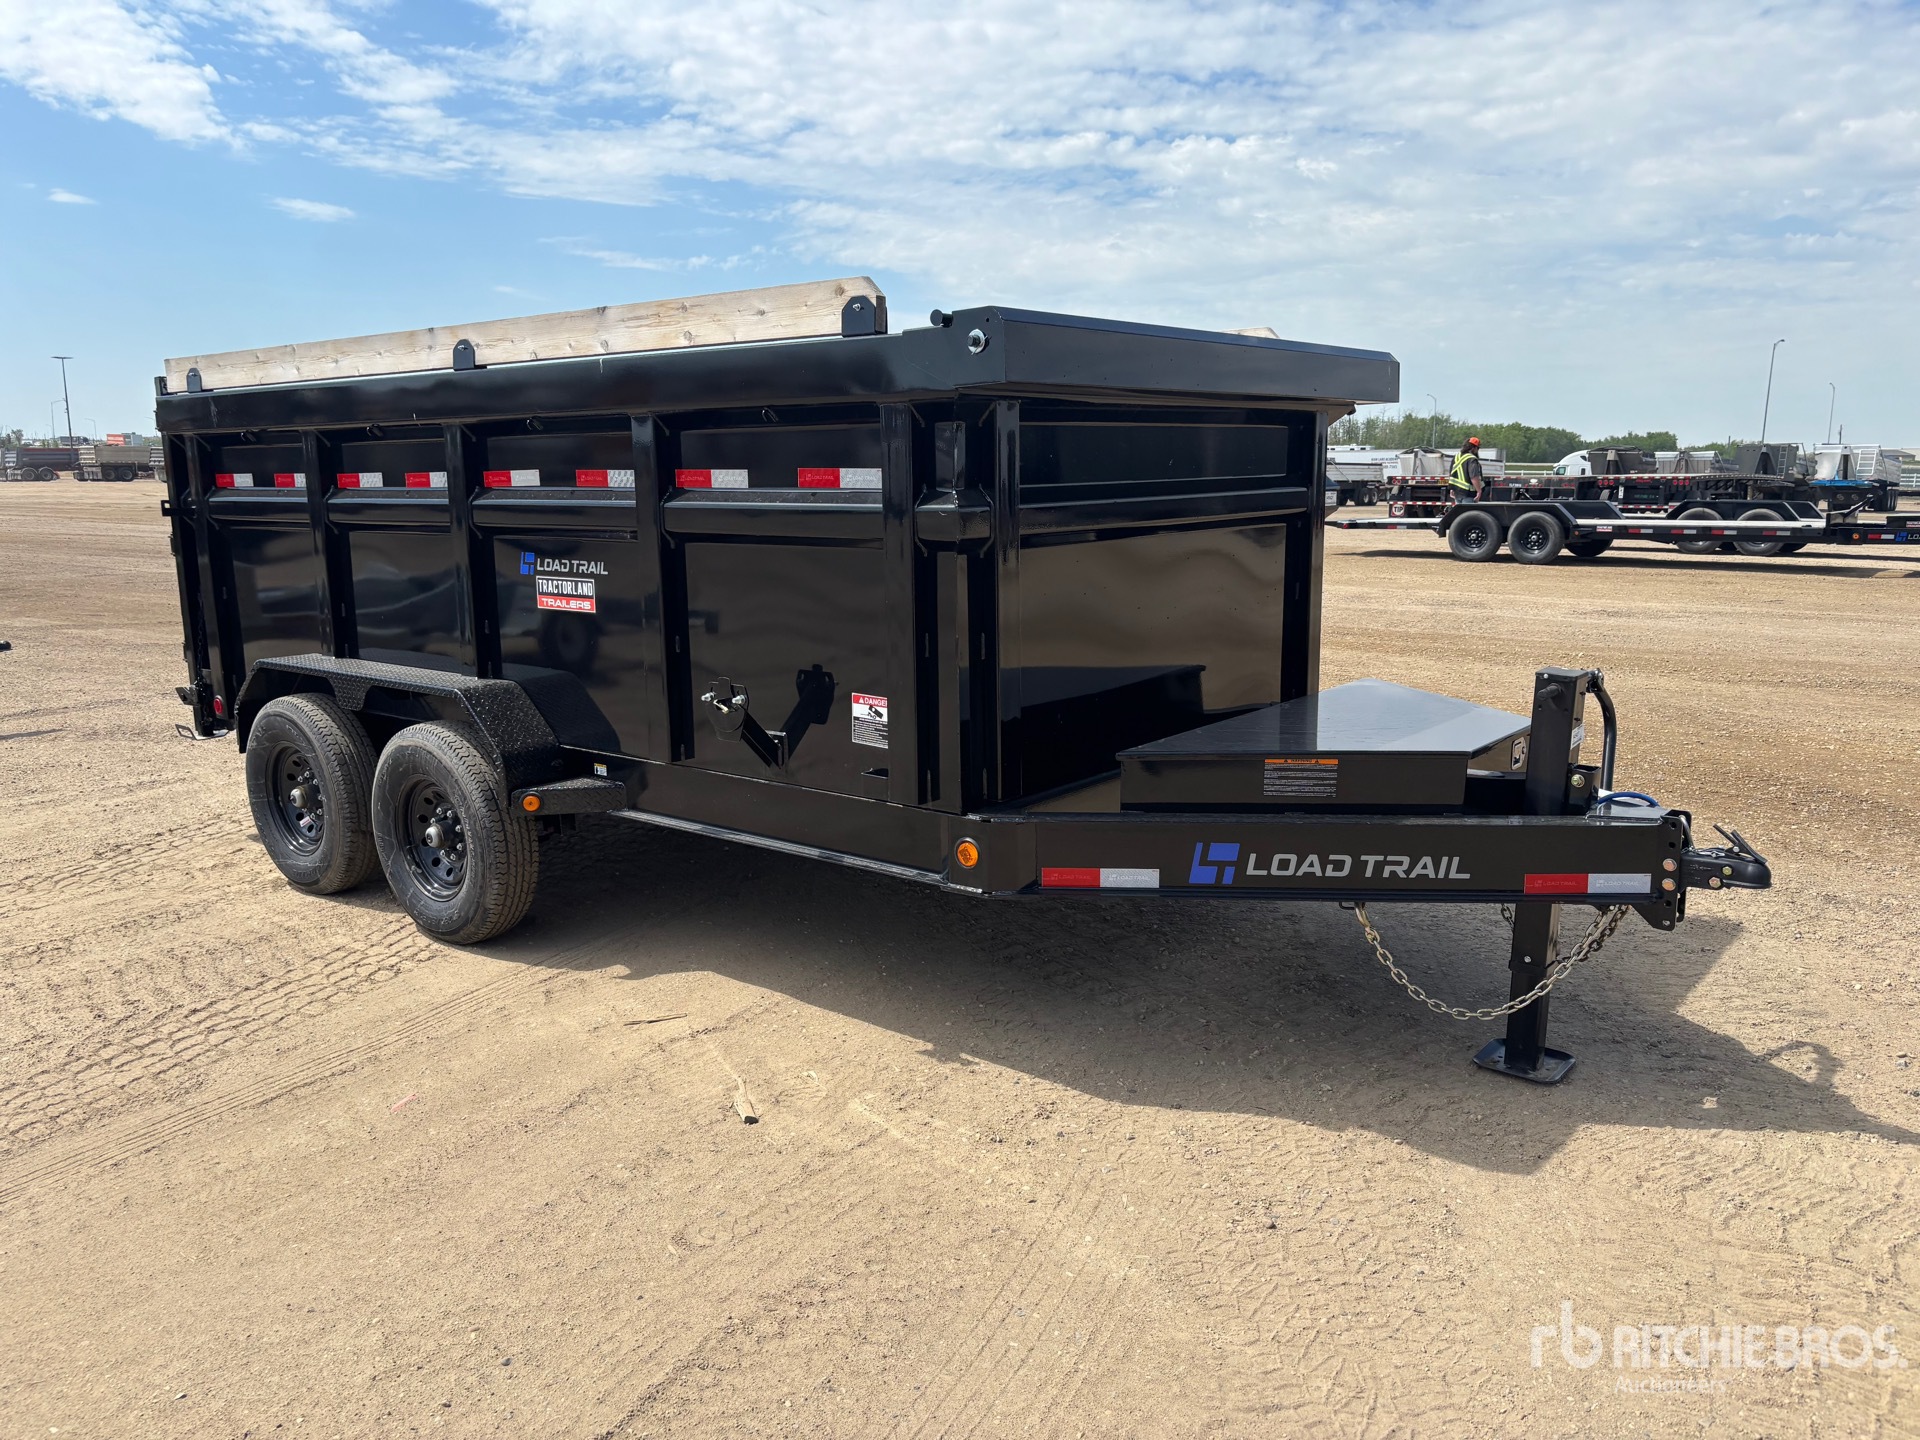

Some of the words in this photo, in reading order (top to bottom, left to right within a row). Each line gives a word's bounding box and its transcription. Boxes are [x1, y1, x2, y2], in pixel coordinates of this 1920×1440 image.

[537, 557, 570, 573] LOAD
[571, 560, 609, 575] TRAIL
[538, 579, 594, 597] TRACTORLAND
[541, 597, 592, 610] TRAILERS
[1246, 852, 1352, 877] LOAD
[1360, 855, 1471, 879] TRAIL
